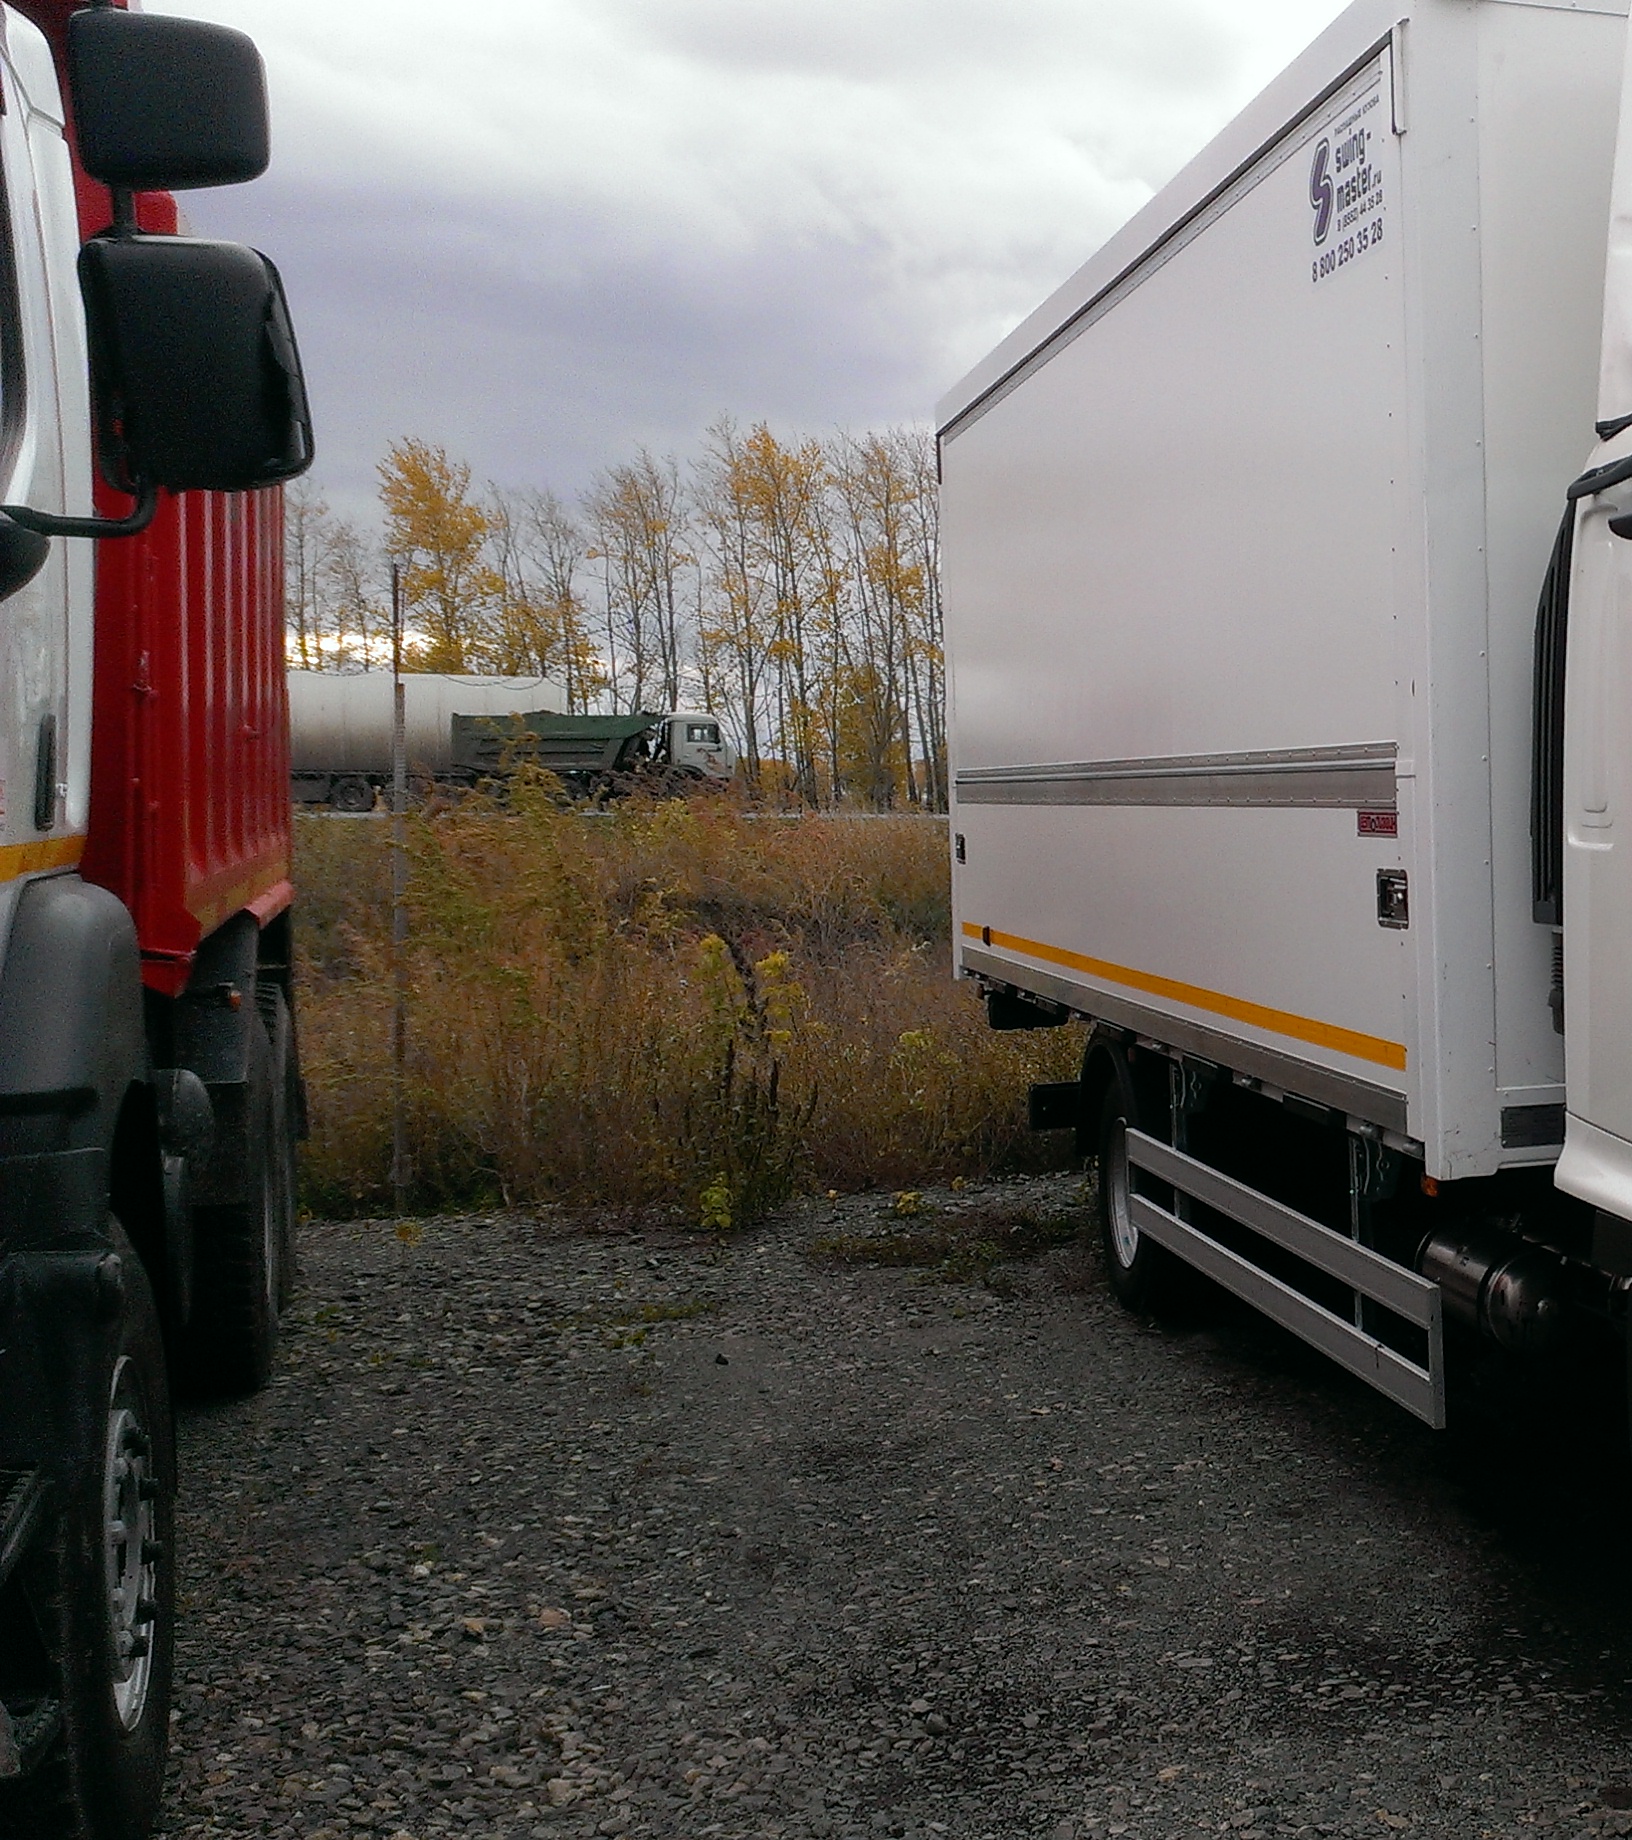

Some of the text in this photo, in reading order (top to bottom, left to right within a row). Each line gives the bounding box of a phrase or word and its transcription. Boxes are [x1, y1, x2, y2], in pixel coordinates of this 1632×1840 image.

[1312, 217, 1383, 282] 8 800 250 35 28
